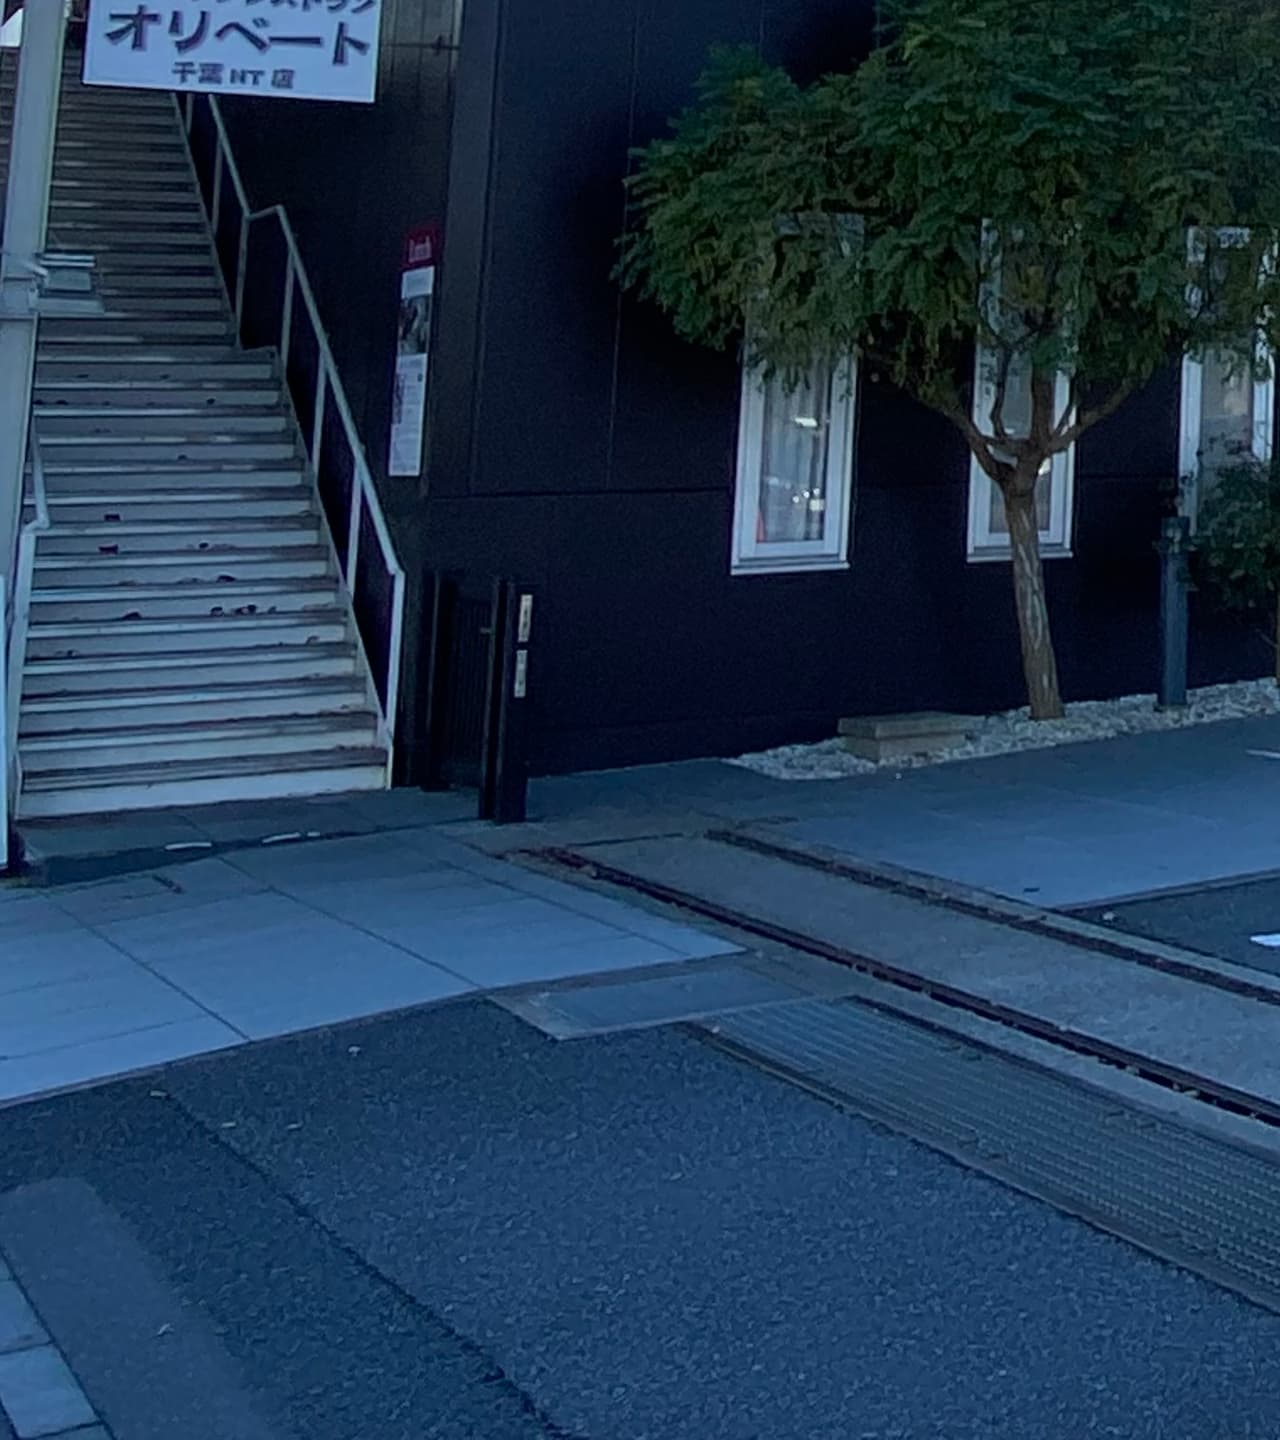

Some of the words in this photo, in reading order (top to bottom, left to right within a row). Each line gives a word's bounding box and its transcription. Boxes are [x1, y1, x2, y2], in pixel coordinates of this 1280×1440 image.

[104, 5, 371, 66] オリベート
